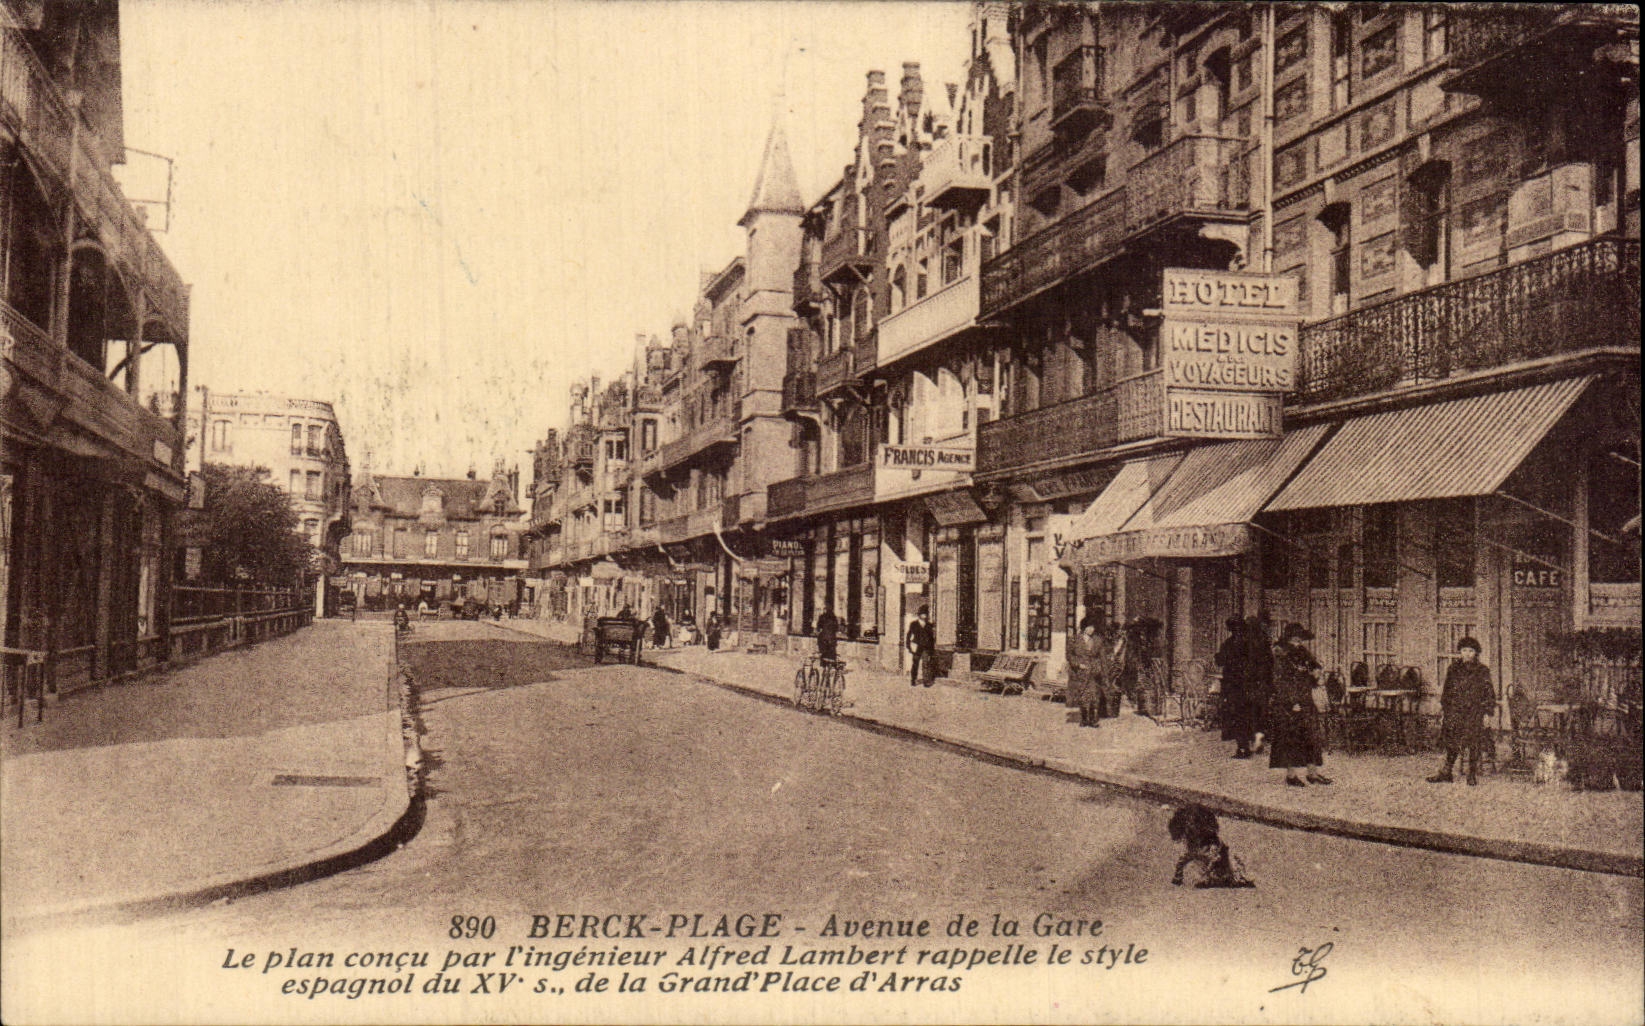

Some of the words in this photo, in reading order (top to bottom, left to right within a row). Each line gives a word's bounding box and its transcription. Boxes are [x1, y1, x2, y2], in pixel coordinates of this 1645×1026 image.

[1169, 360, 1290, 388] VOYAGEURS
[1168, 400, 1279, 435] RESTAURANT
[884, 447, 935, 466] FRANCIS
